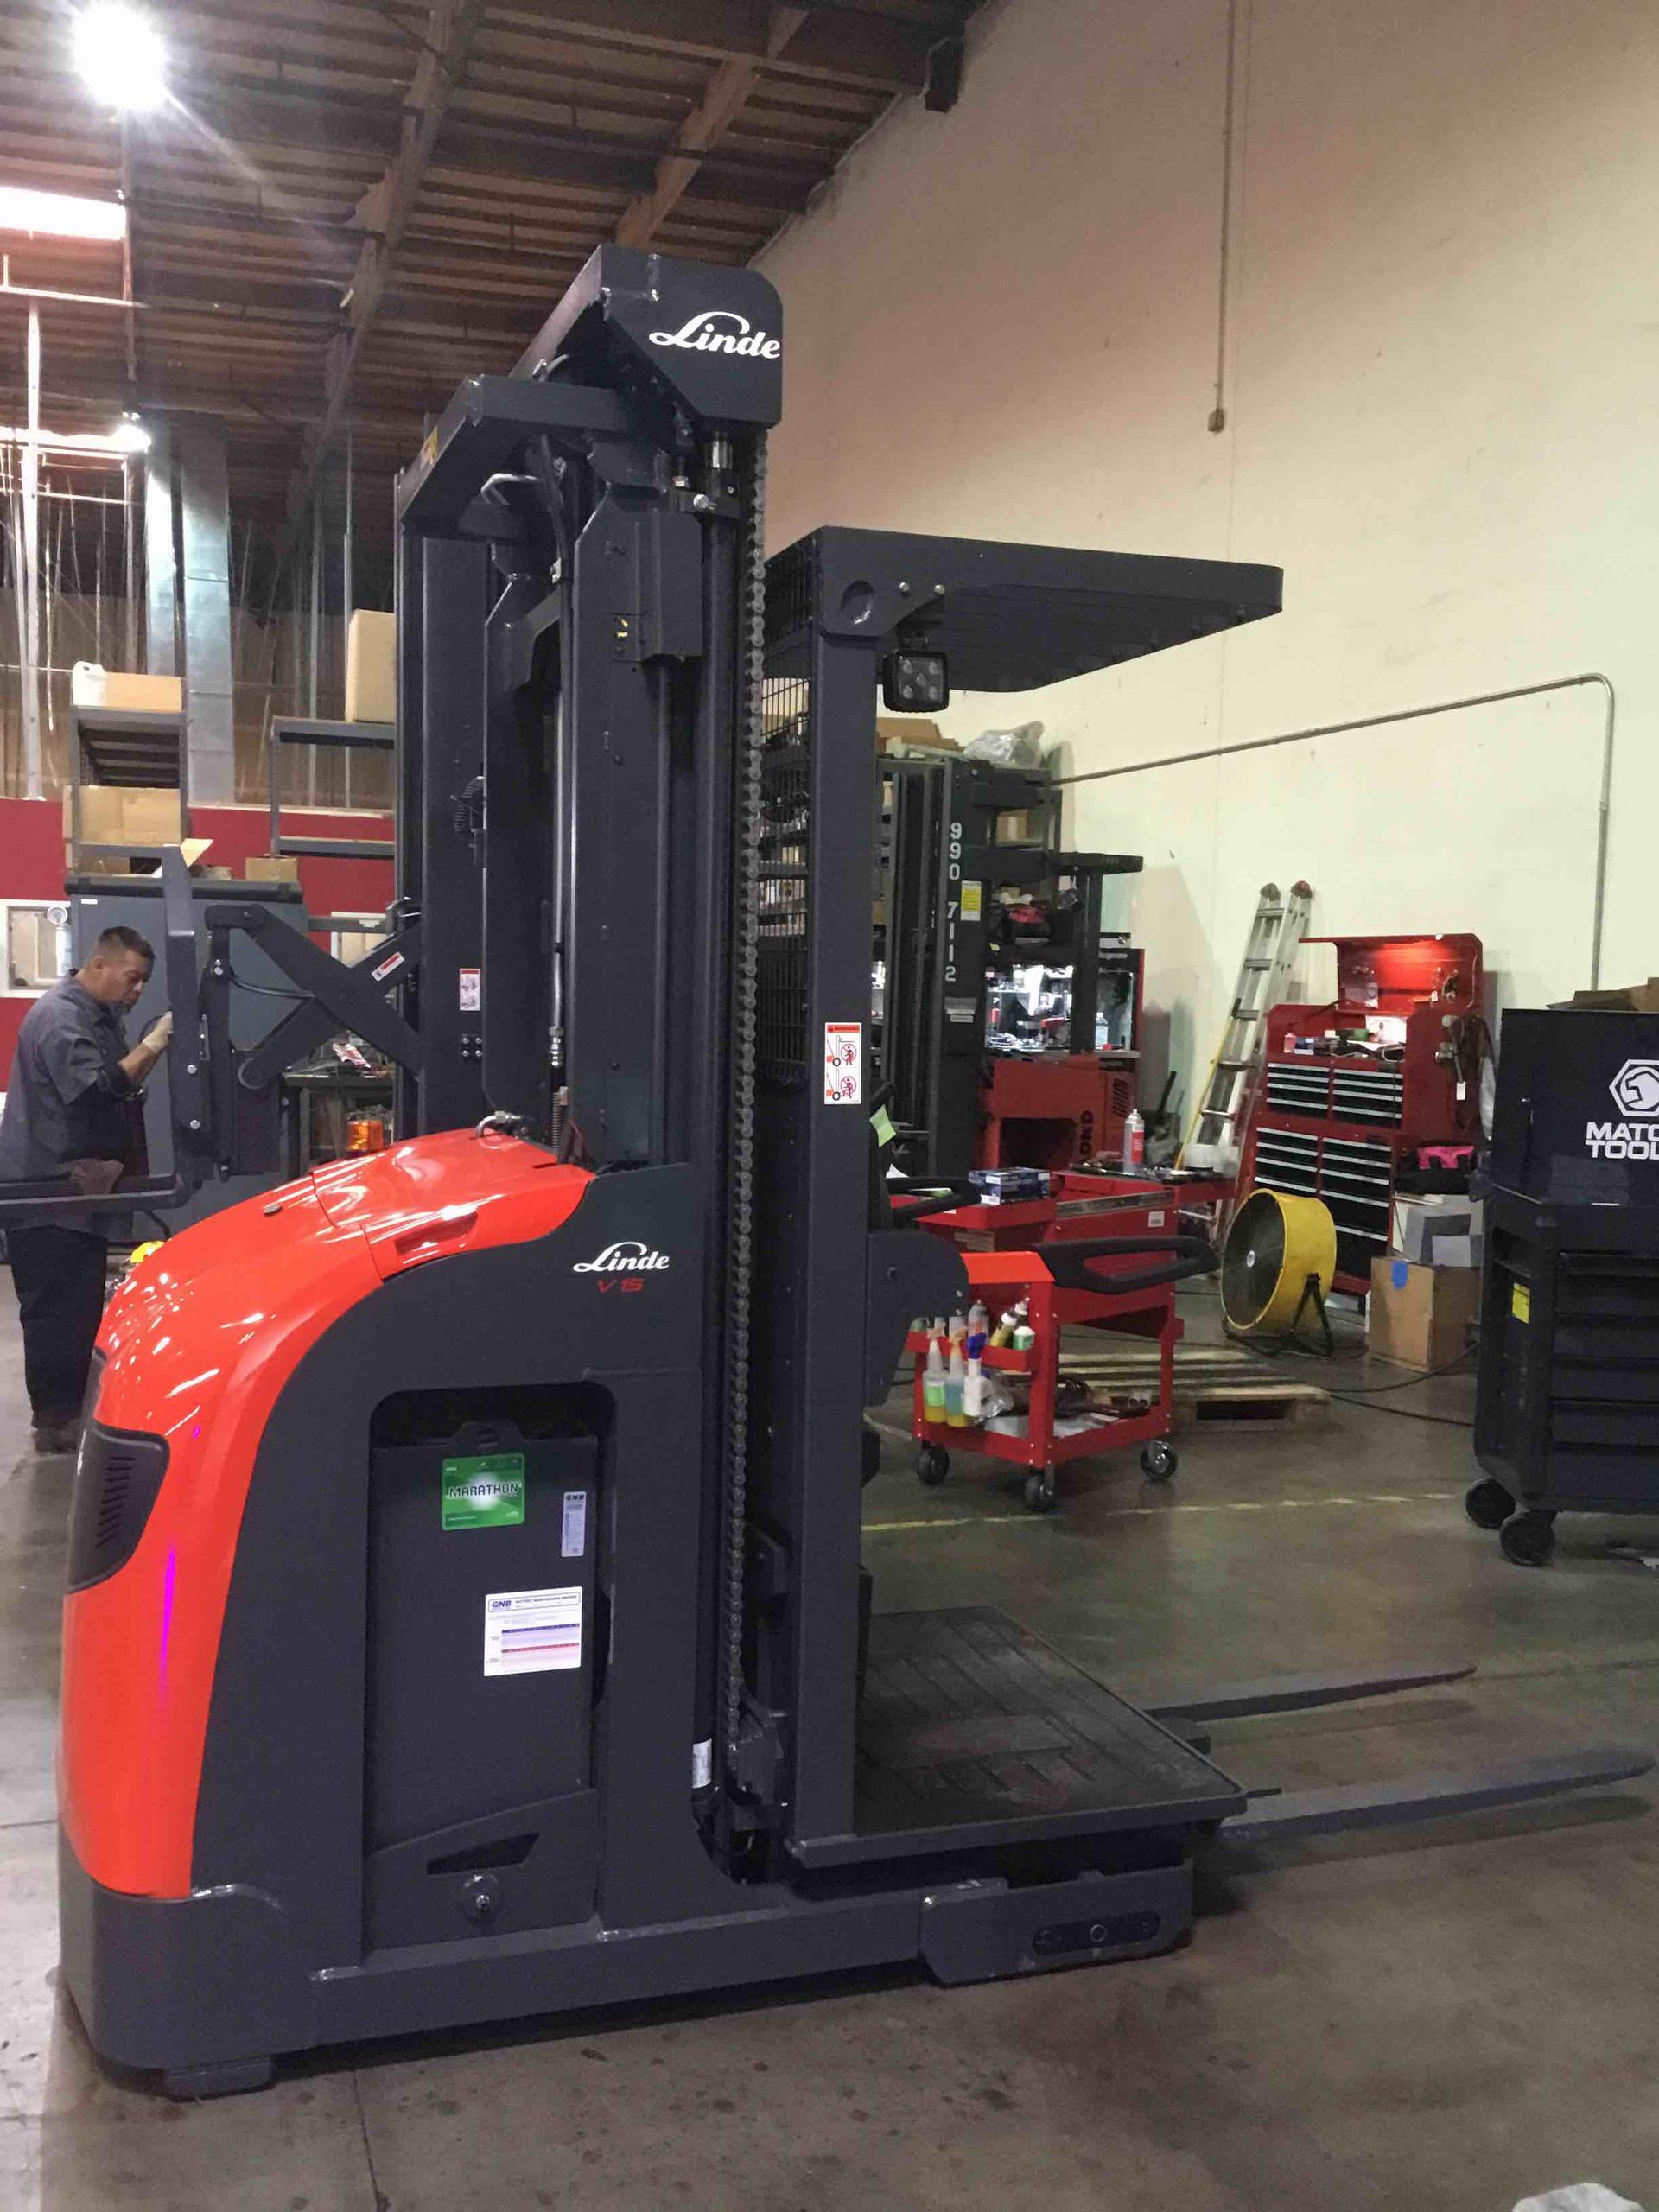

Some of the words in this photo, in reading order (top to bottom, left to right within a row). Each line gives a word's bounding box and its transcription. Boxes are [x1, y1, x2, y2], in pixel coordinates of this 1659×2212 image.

[649, 311, 780, 359] Linde
[949, 822, 963, 880] 990
[573, 1242, 670, 1272] Linde
[449, 1482, 518, 1497] MARATHON
[491, 1599, 512, 1608] GNB
